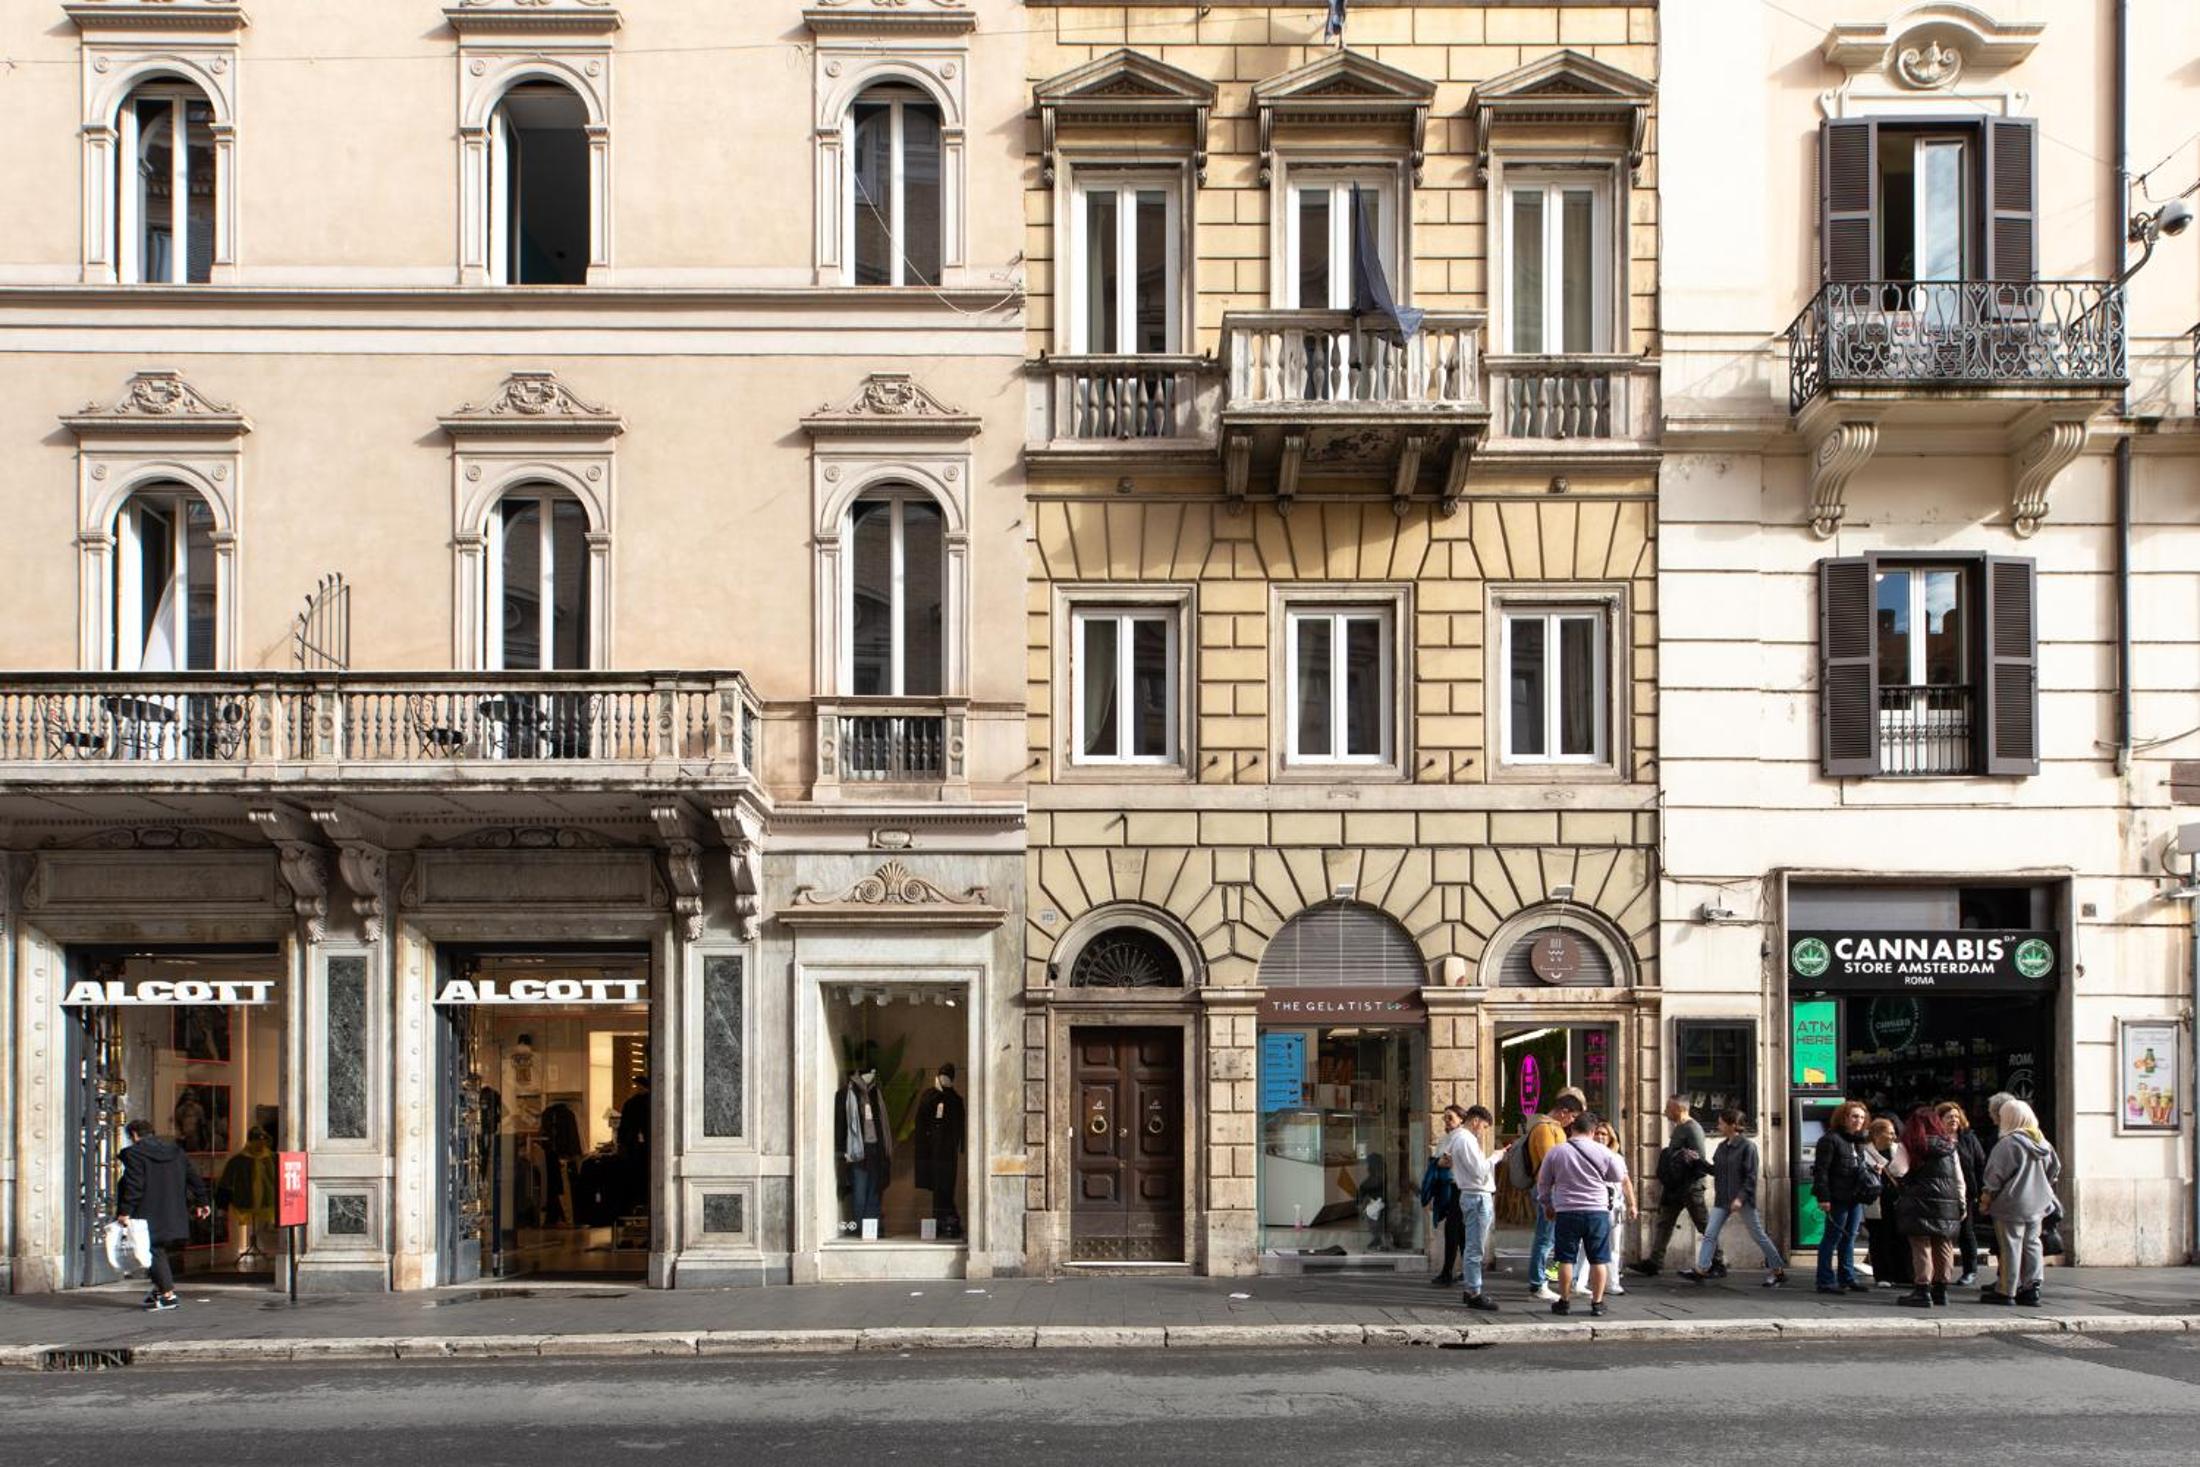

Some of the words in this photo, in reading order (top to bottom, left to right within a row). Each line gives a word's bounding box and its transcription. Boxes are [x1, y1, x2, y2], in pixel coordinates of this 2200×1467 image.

[1835, 938, 2004, 961] CANNABIS
[1844, 962, 1893, 974] STORE
[1897, 962, 1995, 974] AMSTERDAM
[1904, 976, 1935, 985] ROMA
[64, 981, 275, 1002] ALCOTT
[438, 979, 646, 1001] ALCOTT
[1272, 1001, 1300, 1011] THE
[1305, 1001, 1383, 1011] GELATIST
[1796, 1021, 1834, 1033] ATM
[1796, 1035, 1834, 1045] HERE
[2008, 1053, 2034, 1066] ROM
